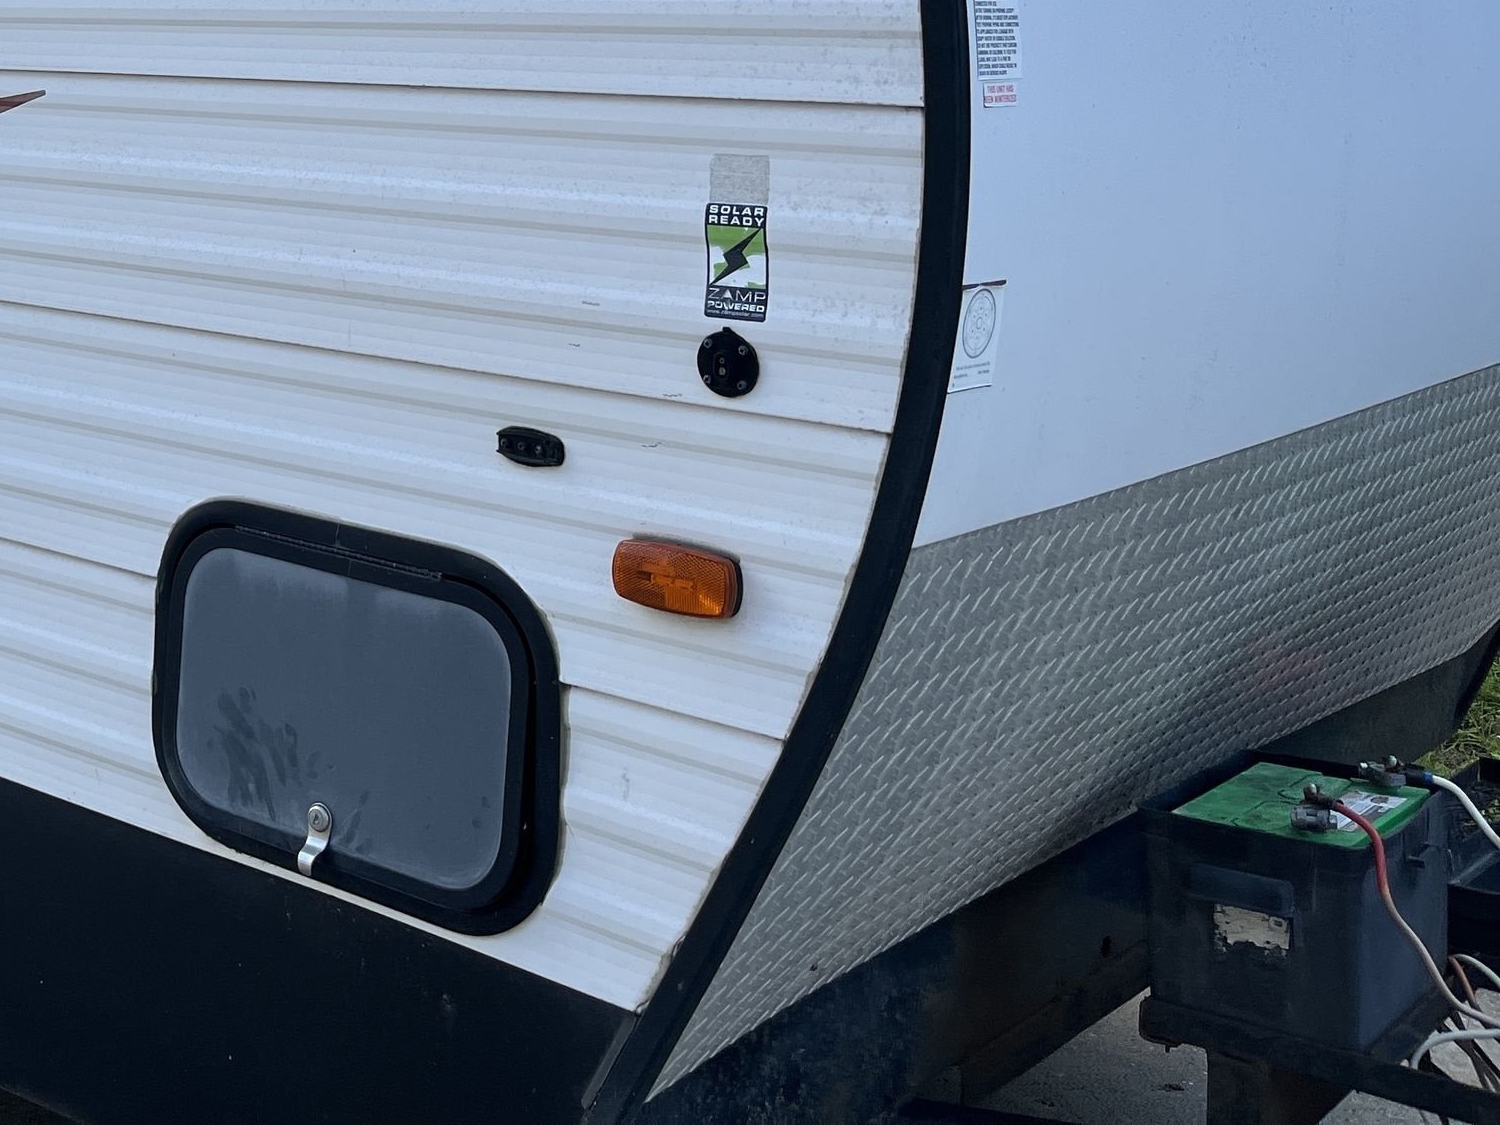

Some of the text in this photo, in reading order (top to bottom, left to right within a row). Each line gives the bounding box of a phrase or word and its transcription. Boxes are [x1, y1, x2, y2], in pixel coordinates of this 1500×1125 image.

[709, 204, 764, 216] SOLAR
[708, 214, 764, 227] READY
[708, 287, 766, 302] ZAMP
[707, 300, 765, 312] POWERED
